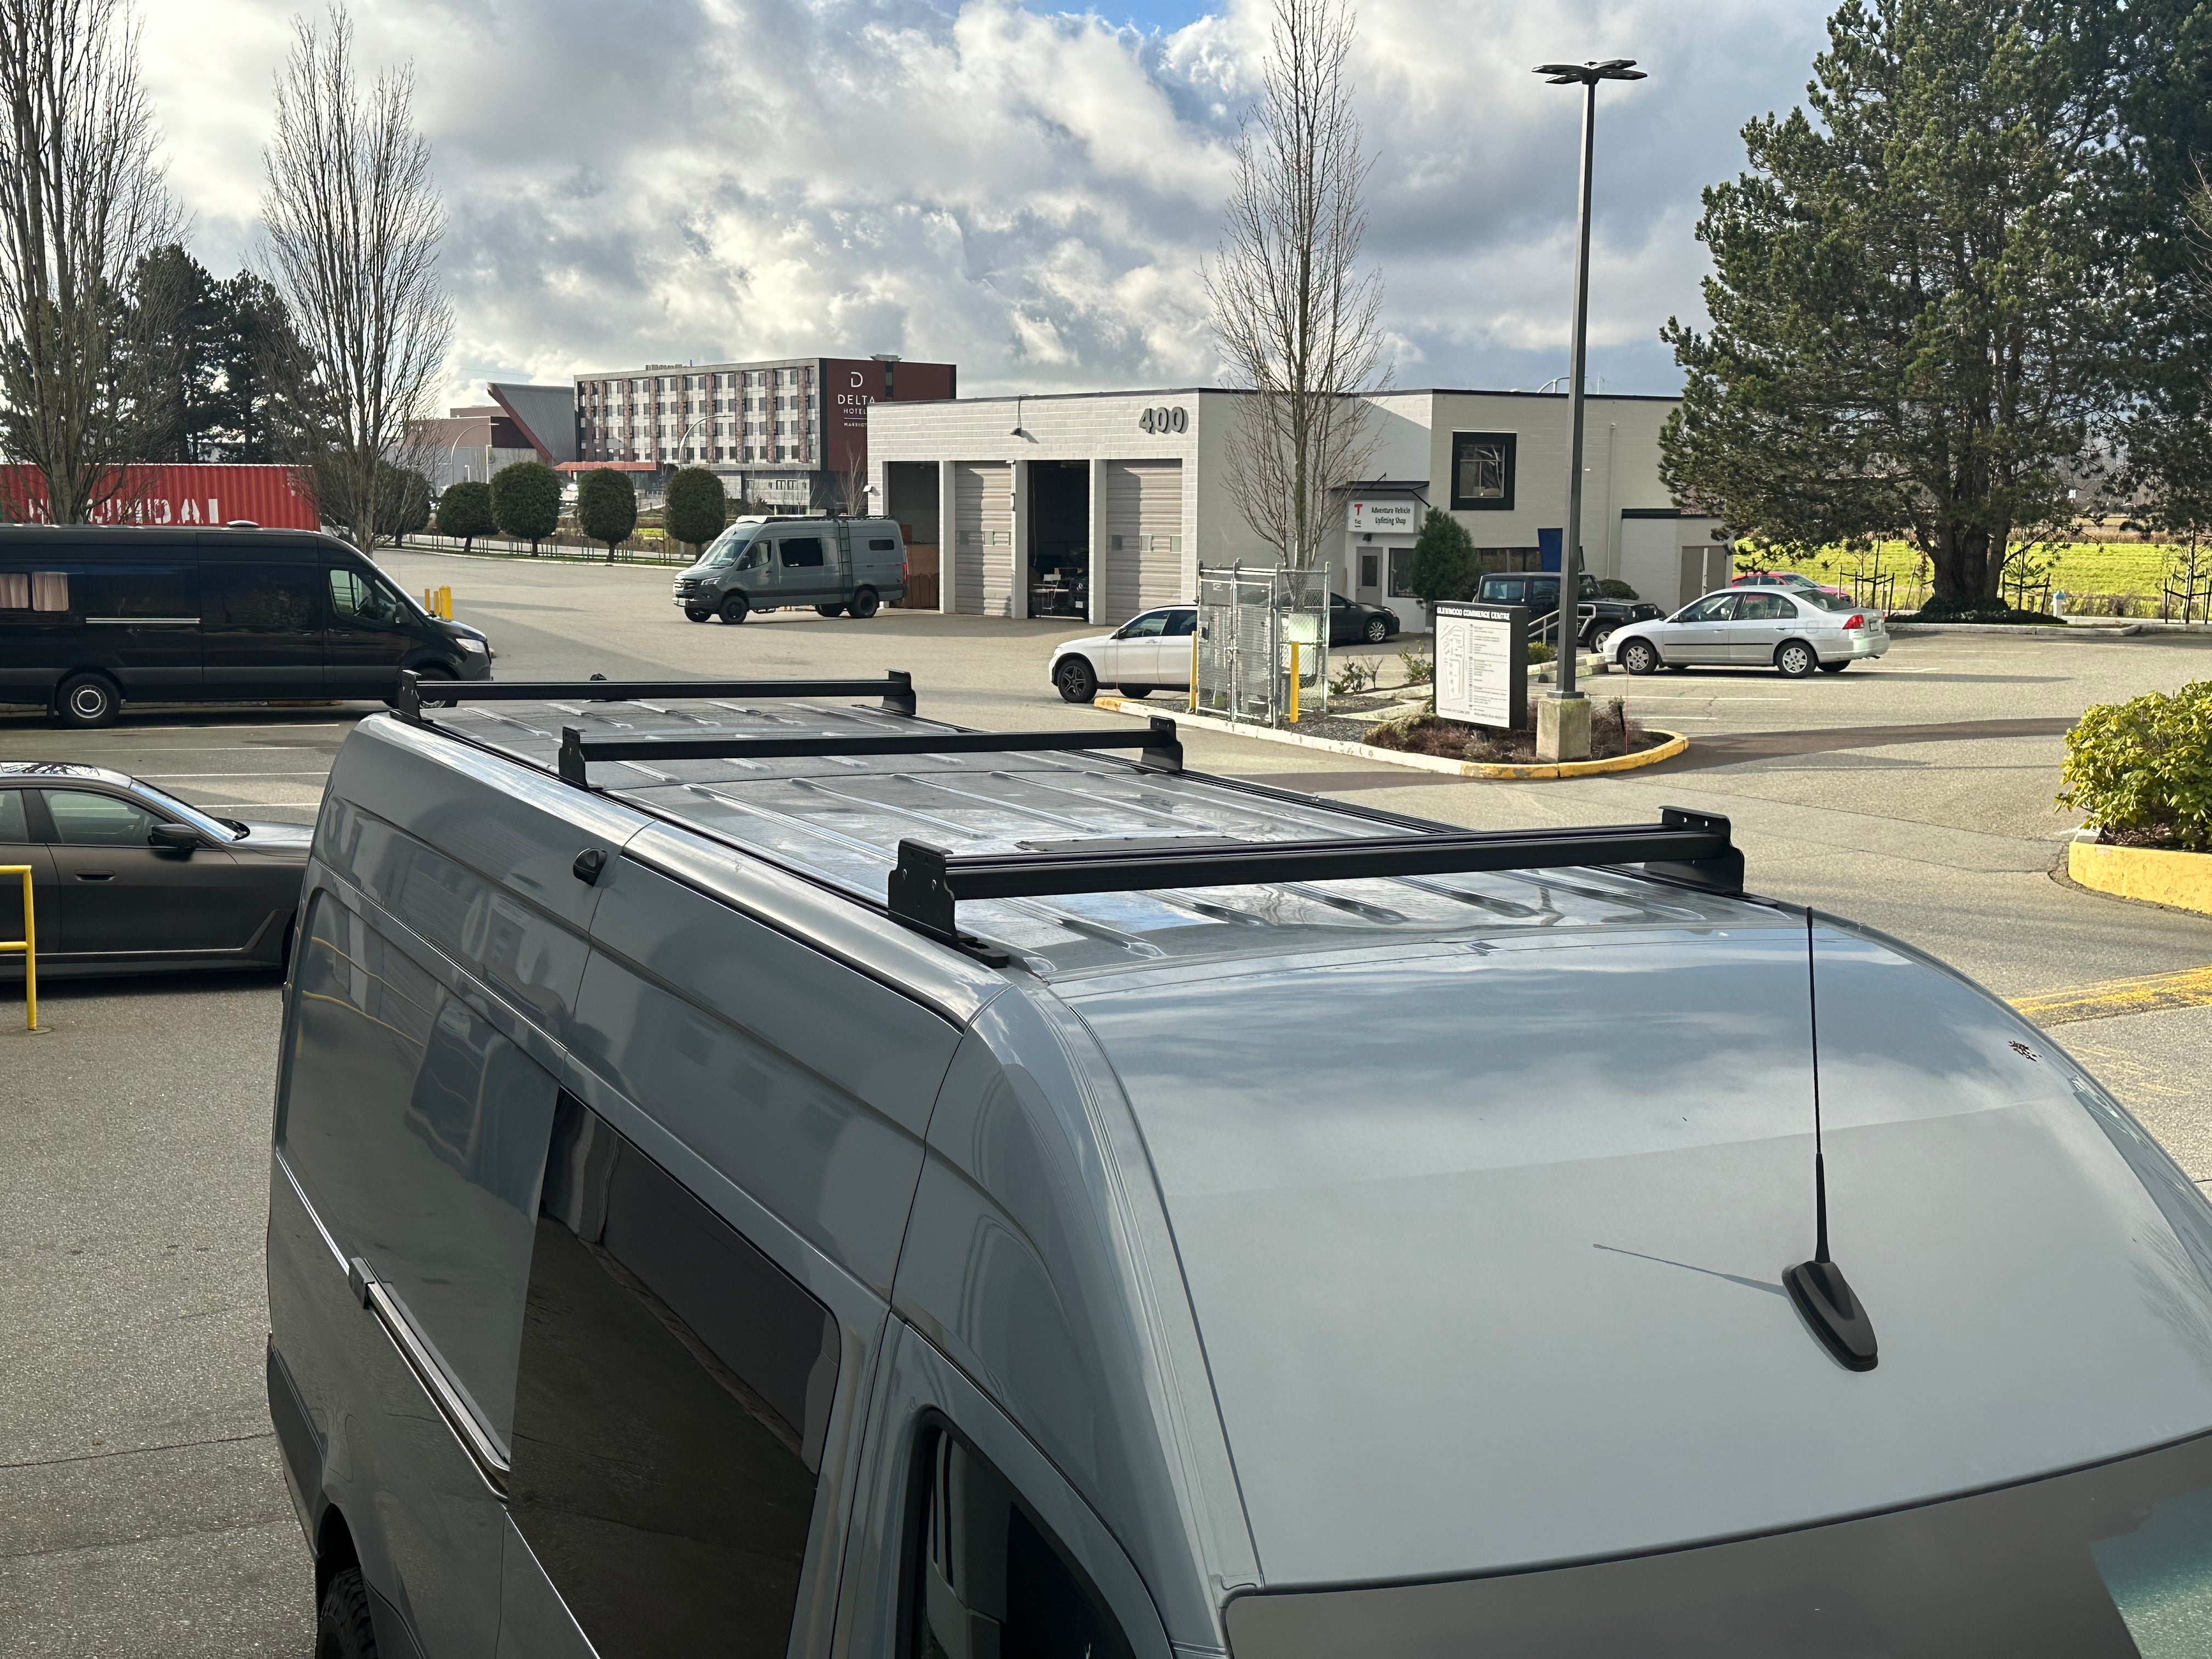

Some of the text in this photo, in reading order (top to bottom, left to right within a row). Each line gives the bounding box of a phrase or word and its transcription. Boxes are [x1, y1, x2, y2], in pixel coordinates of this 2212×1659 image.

[838, 394, 876, 405] DELTA
[1139, 407, 1187, 434] 400
[29, 498, 219, 525] HUNDAI
